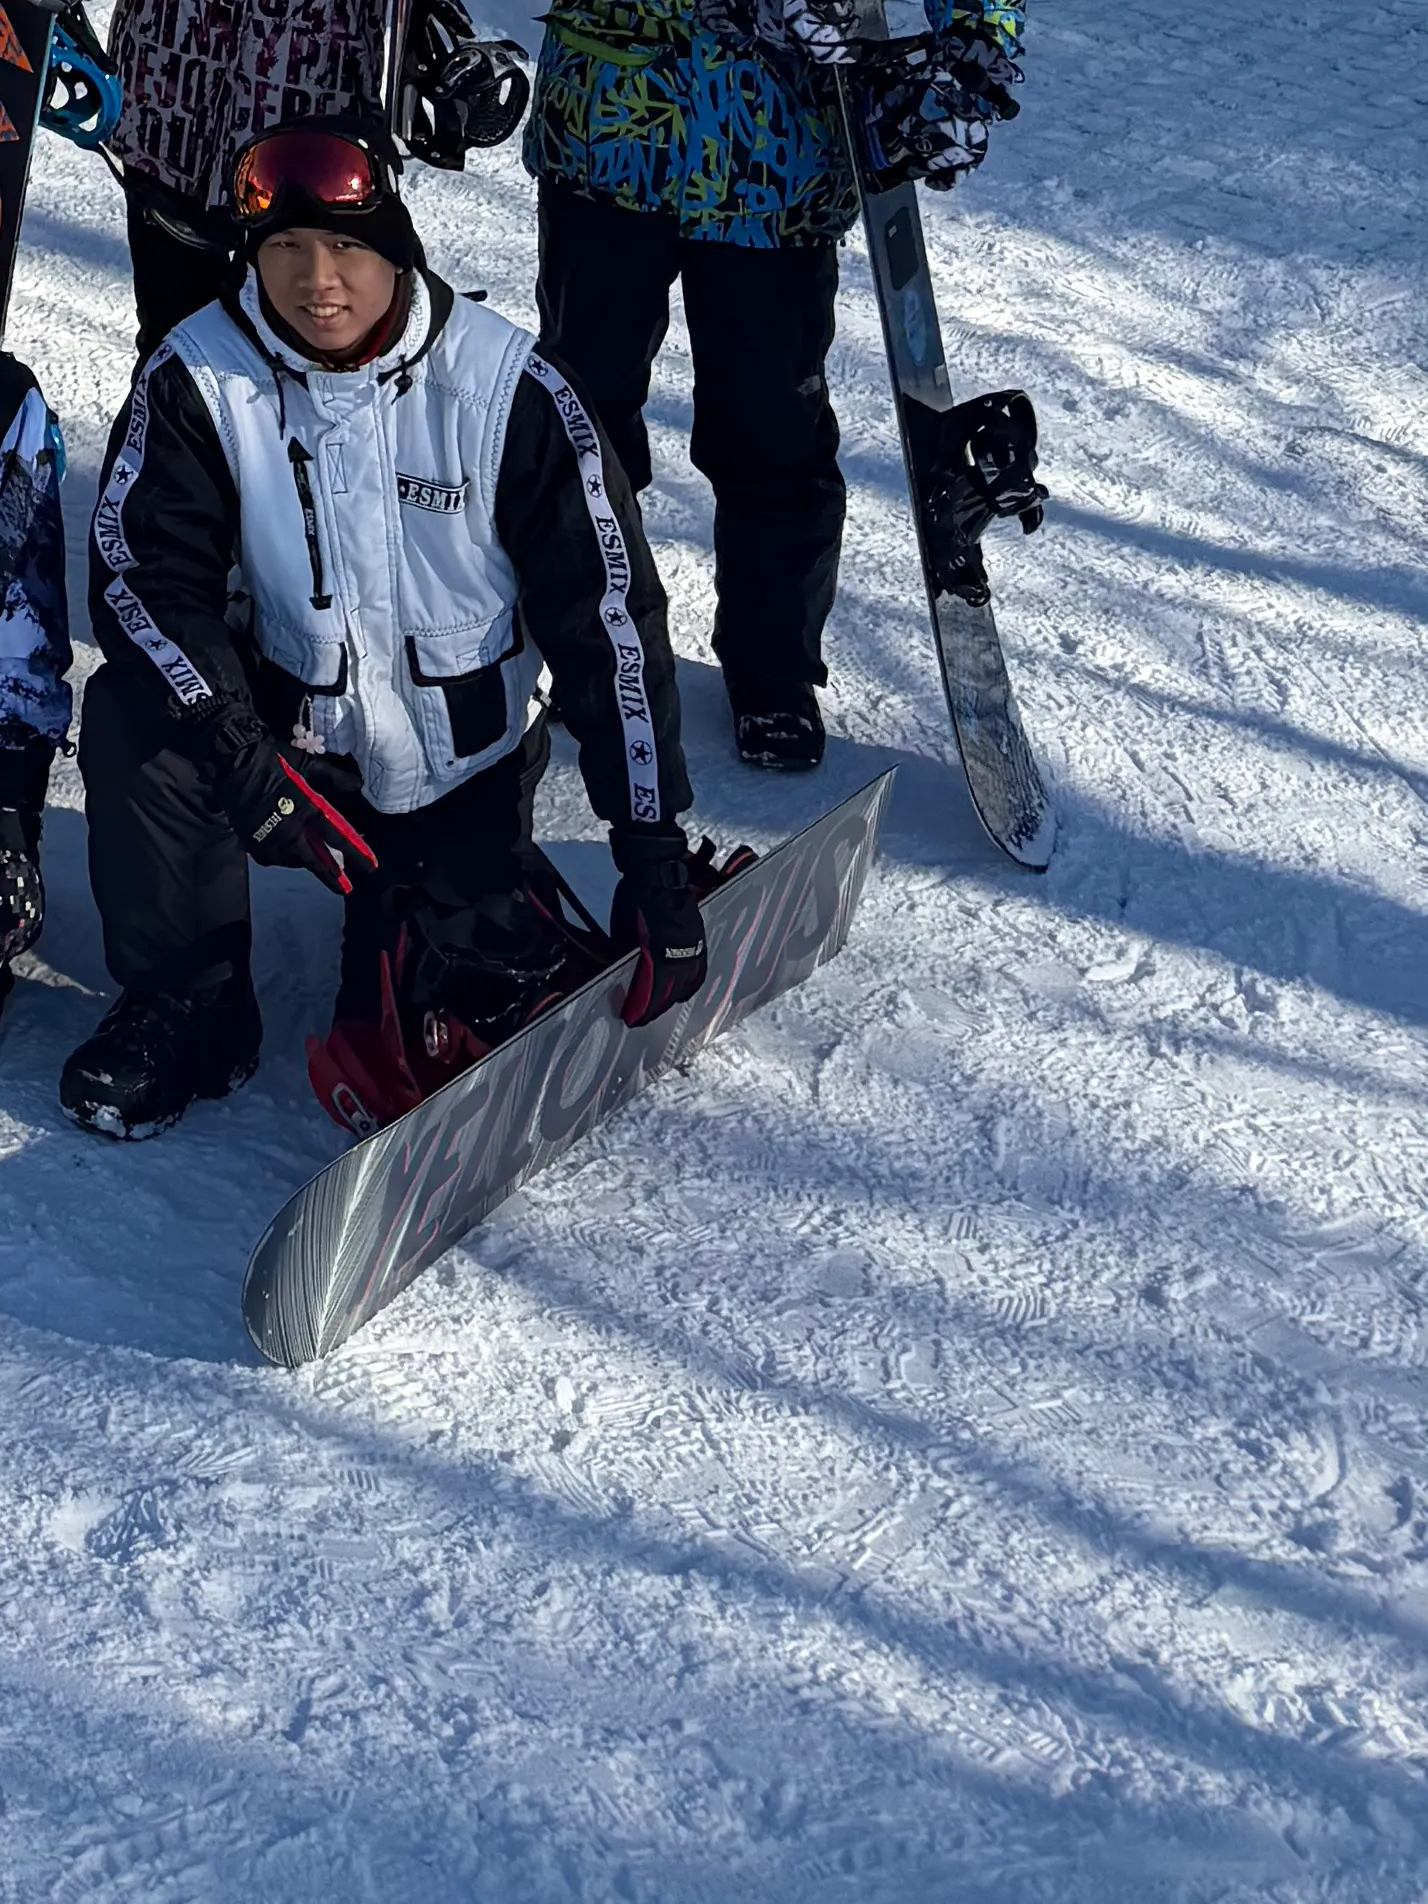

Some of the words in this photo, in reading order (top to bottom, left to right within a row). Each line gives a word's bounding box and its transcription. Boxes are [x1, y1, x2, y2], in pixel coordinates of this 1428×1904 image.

[555, 386, 600, 459] ESMIX
[99, 495, 132, 574] ESMIX
[595, 516, 631, 595] ESMIX
[617, 642, 650, 724] ESMIX
